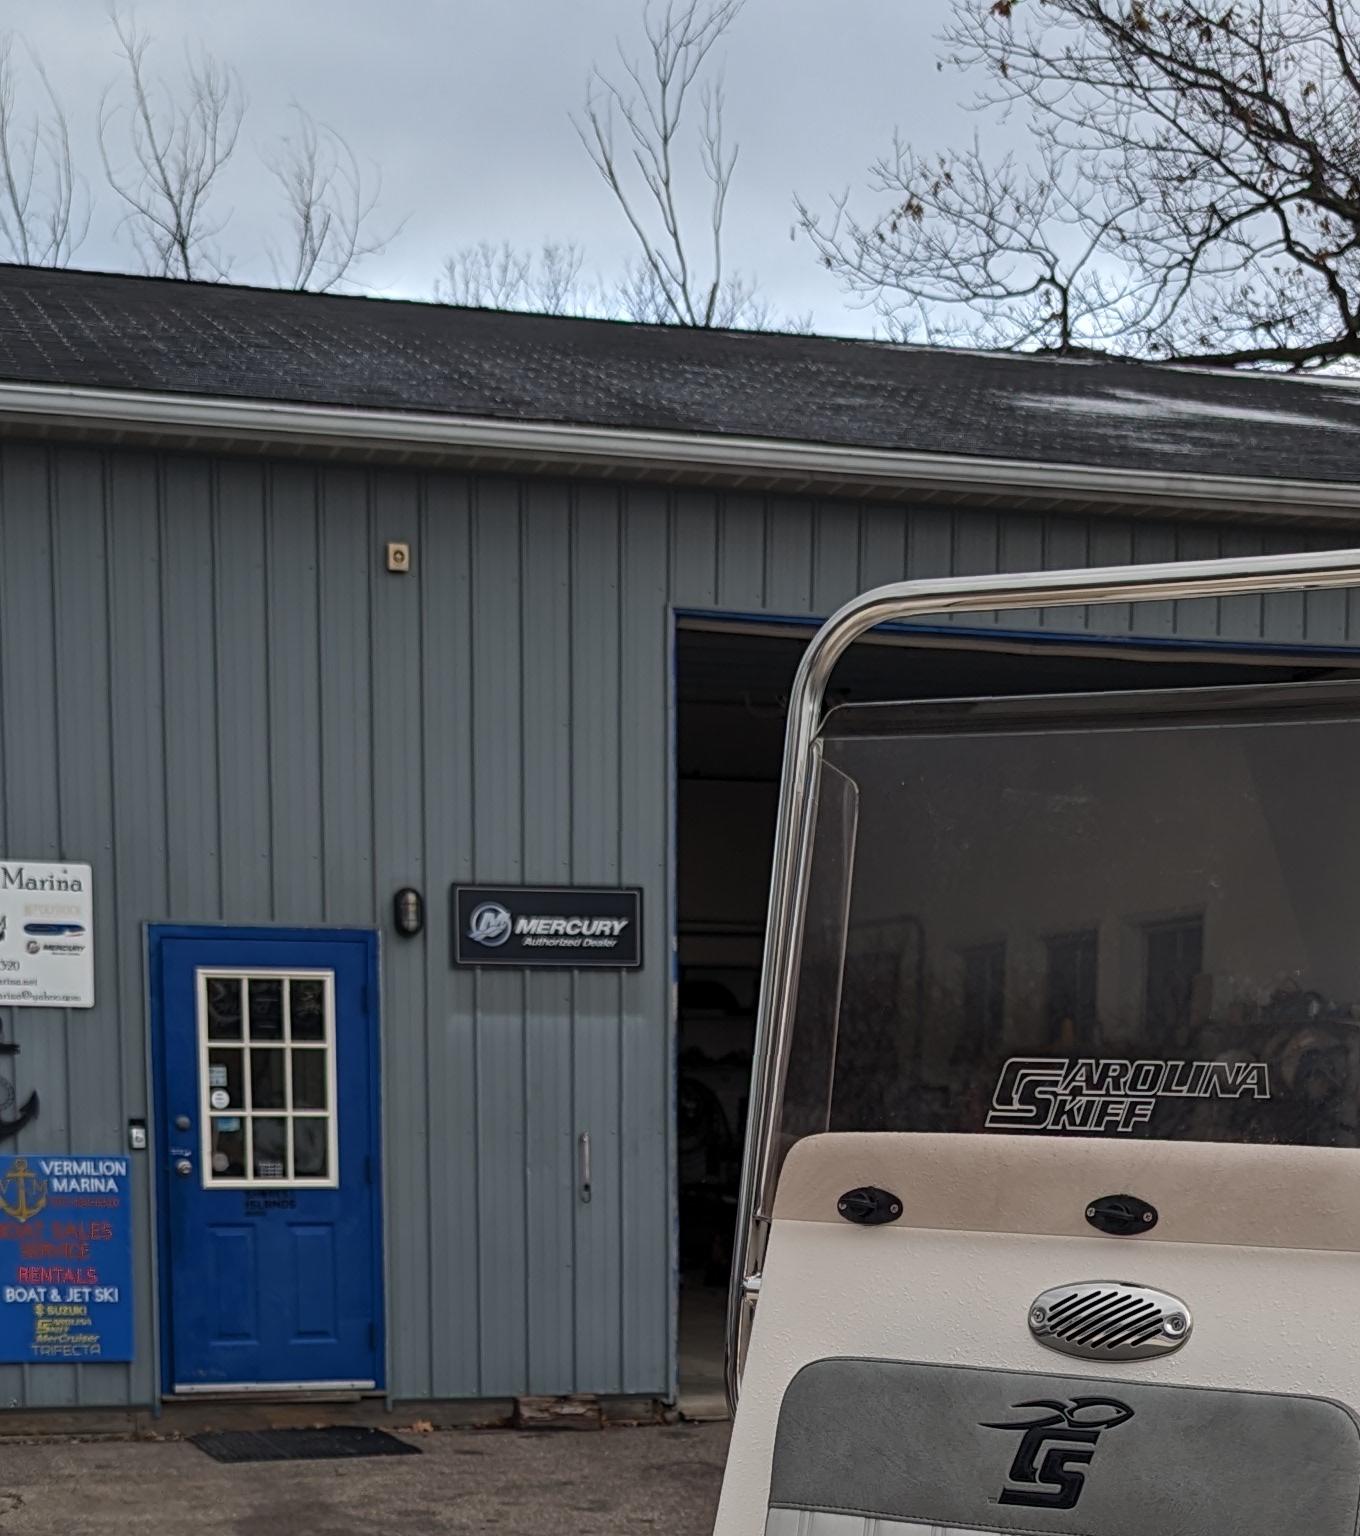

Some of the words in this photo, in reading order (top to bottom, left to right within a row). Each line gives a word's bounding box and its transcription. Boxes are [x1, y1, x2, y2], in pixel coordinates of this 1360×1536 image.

[0, 866, 83, 893] Marina
[514, 917, 629, 936] MERCURY
[522, 936, 582, 948] Authorized
[583, 937, 617, 949] Dealer
[992, 1057, 1272, 1110] CAROLINA
[984, 1077, 1157, 1132] SKIFF
[40, 1160, 127, 1177] VERMILION
[52, 1178, 119, 1193] MARINA
[51, 1222, 114, 1241] SALES
[17, 1266, 99, 1285] RENTALS
[4, 1287, 47, 1303] BOAT
[49, 1288, 63, 1303] &
[64, 1288, 92, 1303] JET
[93, 1288, 120, 1303] SKI
[30, 1343, 102, 1357] TRIFECTA
